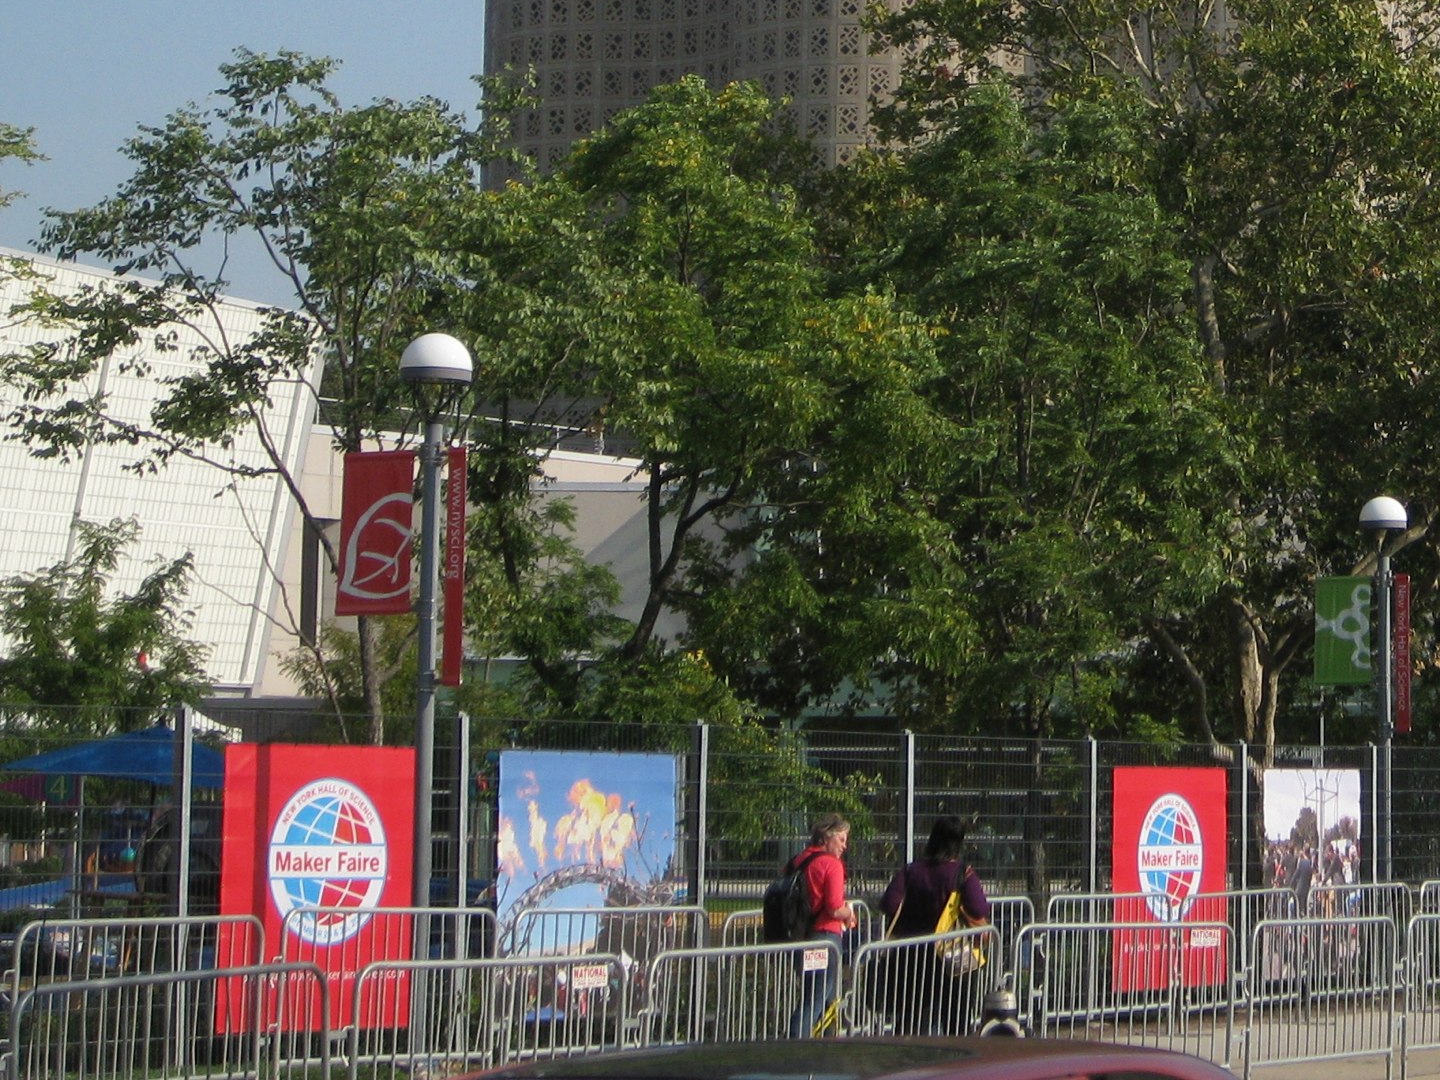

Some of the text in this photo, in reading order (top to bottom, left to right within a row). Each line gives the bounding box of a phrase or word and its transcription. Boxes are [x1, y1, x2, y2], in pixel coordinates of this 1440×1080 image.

[447, 467, 462, 579] www.nysci.org
[1399, 584, 1407, 609] New
[1398, 610, 1407, 632] York
[1398, 635, 1408, 656] Hall
[1398, 671, 1408, 711] Science
[50, 775, 66, 800] 4
[282, 784, 375, 826] NEW YORK HALL OF SCIENCE
[275, 851, 380, 872] Maker Faire
[1142, 850, 1199, 867] Maker Faire
[574, 967, 607, 978] NATIONAL
